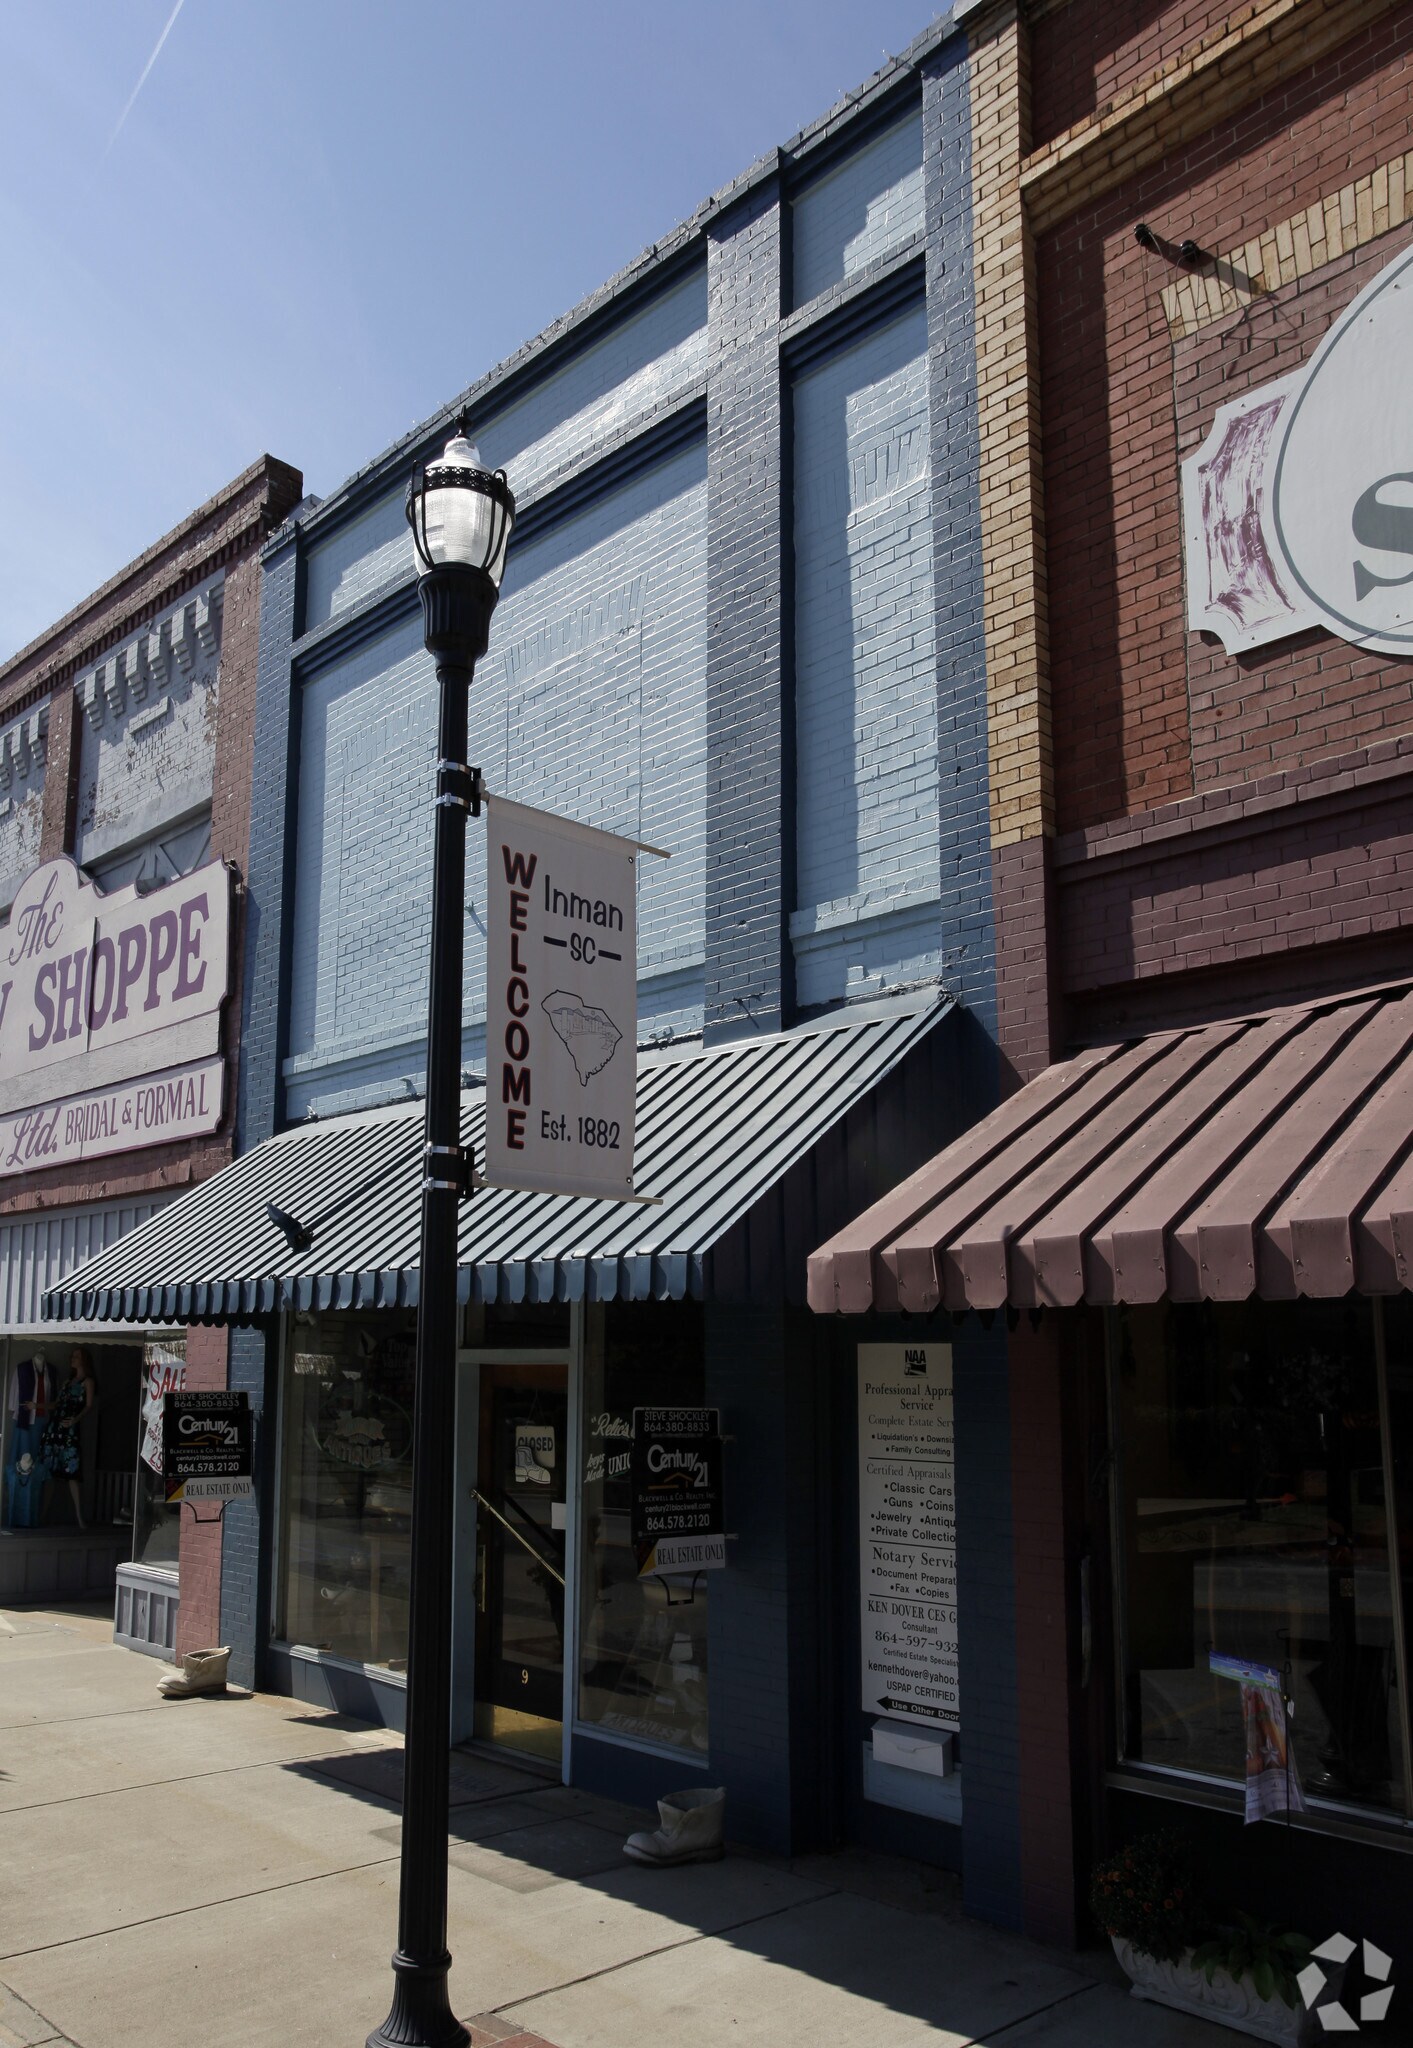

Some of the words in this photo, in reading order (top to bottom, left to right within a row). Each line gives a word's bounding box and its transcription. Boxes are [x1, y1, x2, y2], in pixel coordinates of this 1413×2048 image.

[545, 875, 623, 932] Inman
[9, 871, 63, 966] The
[29, 892, 209, 1052] SHOPPE
[502, 844, 537, 1150] WELCOME
[6, 1106, 61, 1167] Ltd.
[65, 1098, 118, 1145] BRIDAL
[122, 1099, 131, 1124] &
[136, 1074, 208, 1130] FORMAL
[541, 1110, 571, 1142] Est.
[578, 1116, 620, 1149] 1882
[905, 1350, 926, 1363] NAA
[150, 1360, 186, 1401] SALE
[865, 1383, 920, 1396] Professional
[174, 1400, 240, 1408] 864-380-8833
[900, 1398, 934, 1410] Service
[645, 1412, 666, 1421] STEVE
[669, 1412, 710, 1421] SHOCKLEY
[869, 1415, 905, 1428] Complete
[908, 1416, 934, 1426] Estate
[178, 1415, 229, 1434] Century
[224, 1427, 239, 1444] 21
[644, 1422, 710, 1432] 864-380-8833
[518, 1437, 553, 1451] CLOSED
[877, 1433, 918, 1442] Liquidation's
[891, 1445, 912, 1454] Family
[915, 1446, 951, 1457] Consulting
[177, 1462, 240, 1473] 864.578.2120
[647, 1444, 699, 1472] Century
[694, 1462, 709, 1487] 21
[867, 1463, 903, 1476] Certified
[907, 1466, 951, 1481] Appraisals
[186, 1484, 204, 1496] REAL
[207, 1483, 230, 1495] ESTATE
[233, 1482, 250, 1494] ONLY
[890, 1482, 925, 1495] Classic
[929, 1485, 952, 1496] Cars
[889, 1497, 913, 1508] Guns
[926, 1499, 954, 1511] Coins
[647, 1514, 710, 1531] 864.578.2120
[875, 1511, 912, 1525] Jewelry
[924, 1515, 956, 1529] Antiqu
[876, 1526, 908, 1538] Private
[912, 1529, 956, 1542] Collectio
[657, 1548, 676, 1565] REAL
[678, 1546, 703, 1563] ESTATE
[705, 1544, 724, 1560] ONLY
[873, 1547, 915, 1568] Notary
[877, 1567, 917, 1581] Document
[895, 1584, 909, 1594] Fax
[920, 1587, 949, 1599] Copies
[868, 1600, 888, 1613] KEN
[892, 1604, 924, 1620] DOVER
[928, 1608, 946, 1622] CES
[902, 1621, 938, 1635] Consultant
[883, 1648, 907, 1659] Certified
[909, 1652, 928, 1662] Estate
[521, 1669, 529, 1686] 9
[887, 1680, 912, 1693] USPAP
[915, 1686, 956, 1702] CERTIFIED
[891, 1700, 908, 1711] Use
[911, 1703, 935, 1716] Other
[938, 1707, 959, 1721] Door
